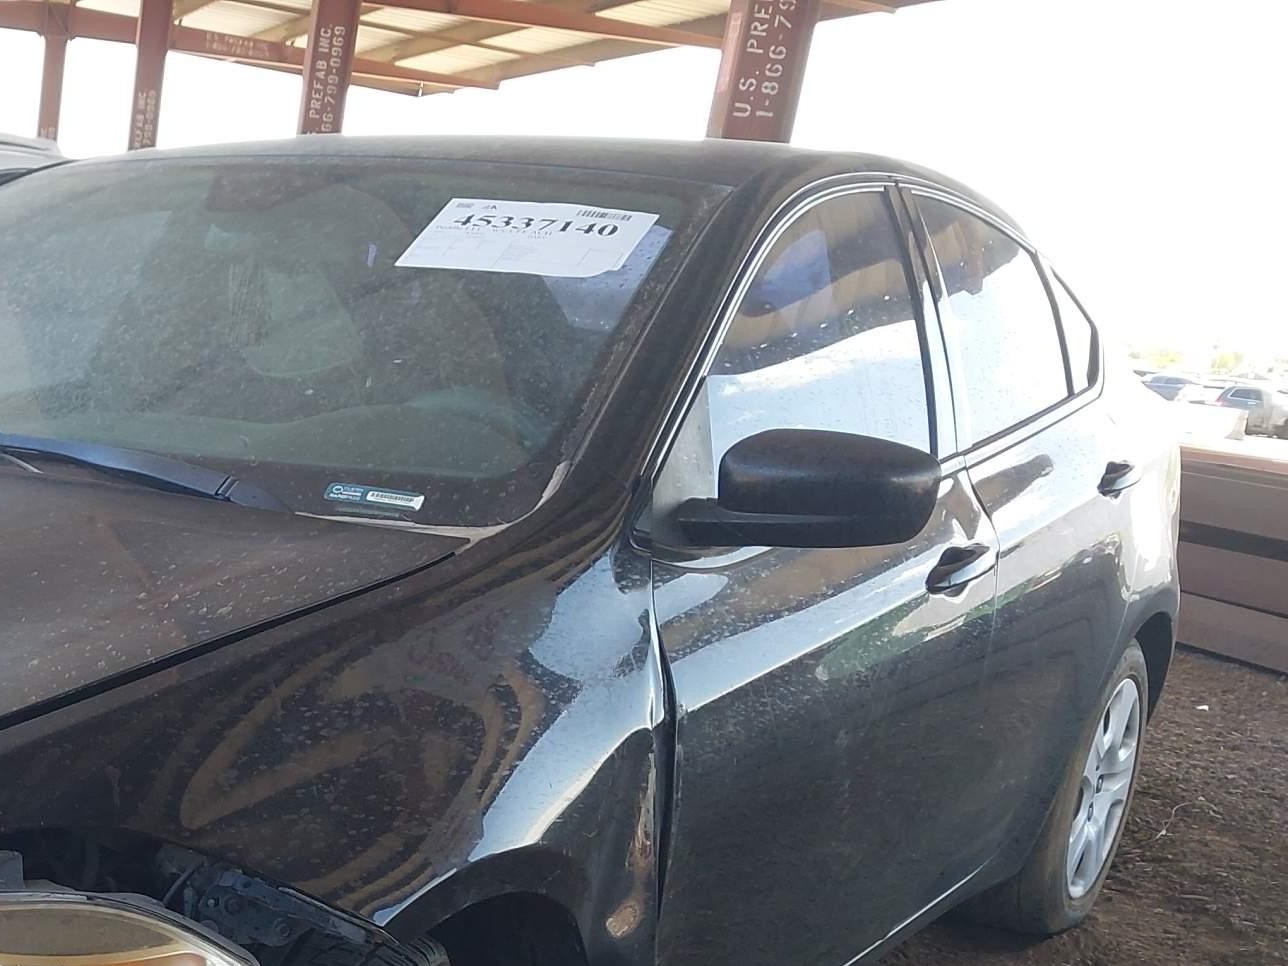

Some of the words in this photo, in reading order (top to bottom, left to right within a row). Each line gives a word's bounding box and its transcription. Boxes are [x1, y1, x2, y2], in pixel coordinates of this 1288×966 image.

[308, 59, 329, 119] PREFAB
[732, 70, 760, 117] U.S.
[453, 213, 619, 237] 45337140
